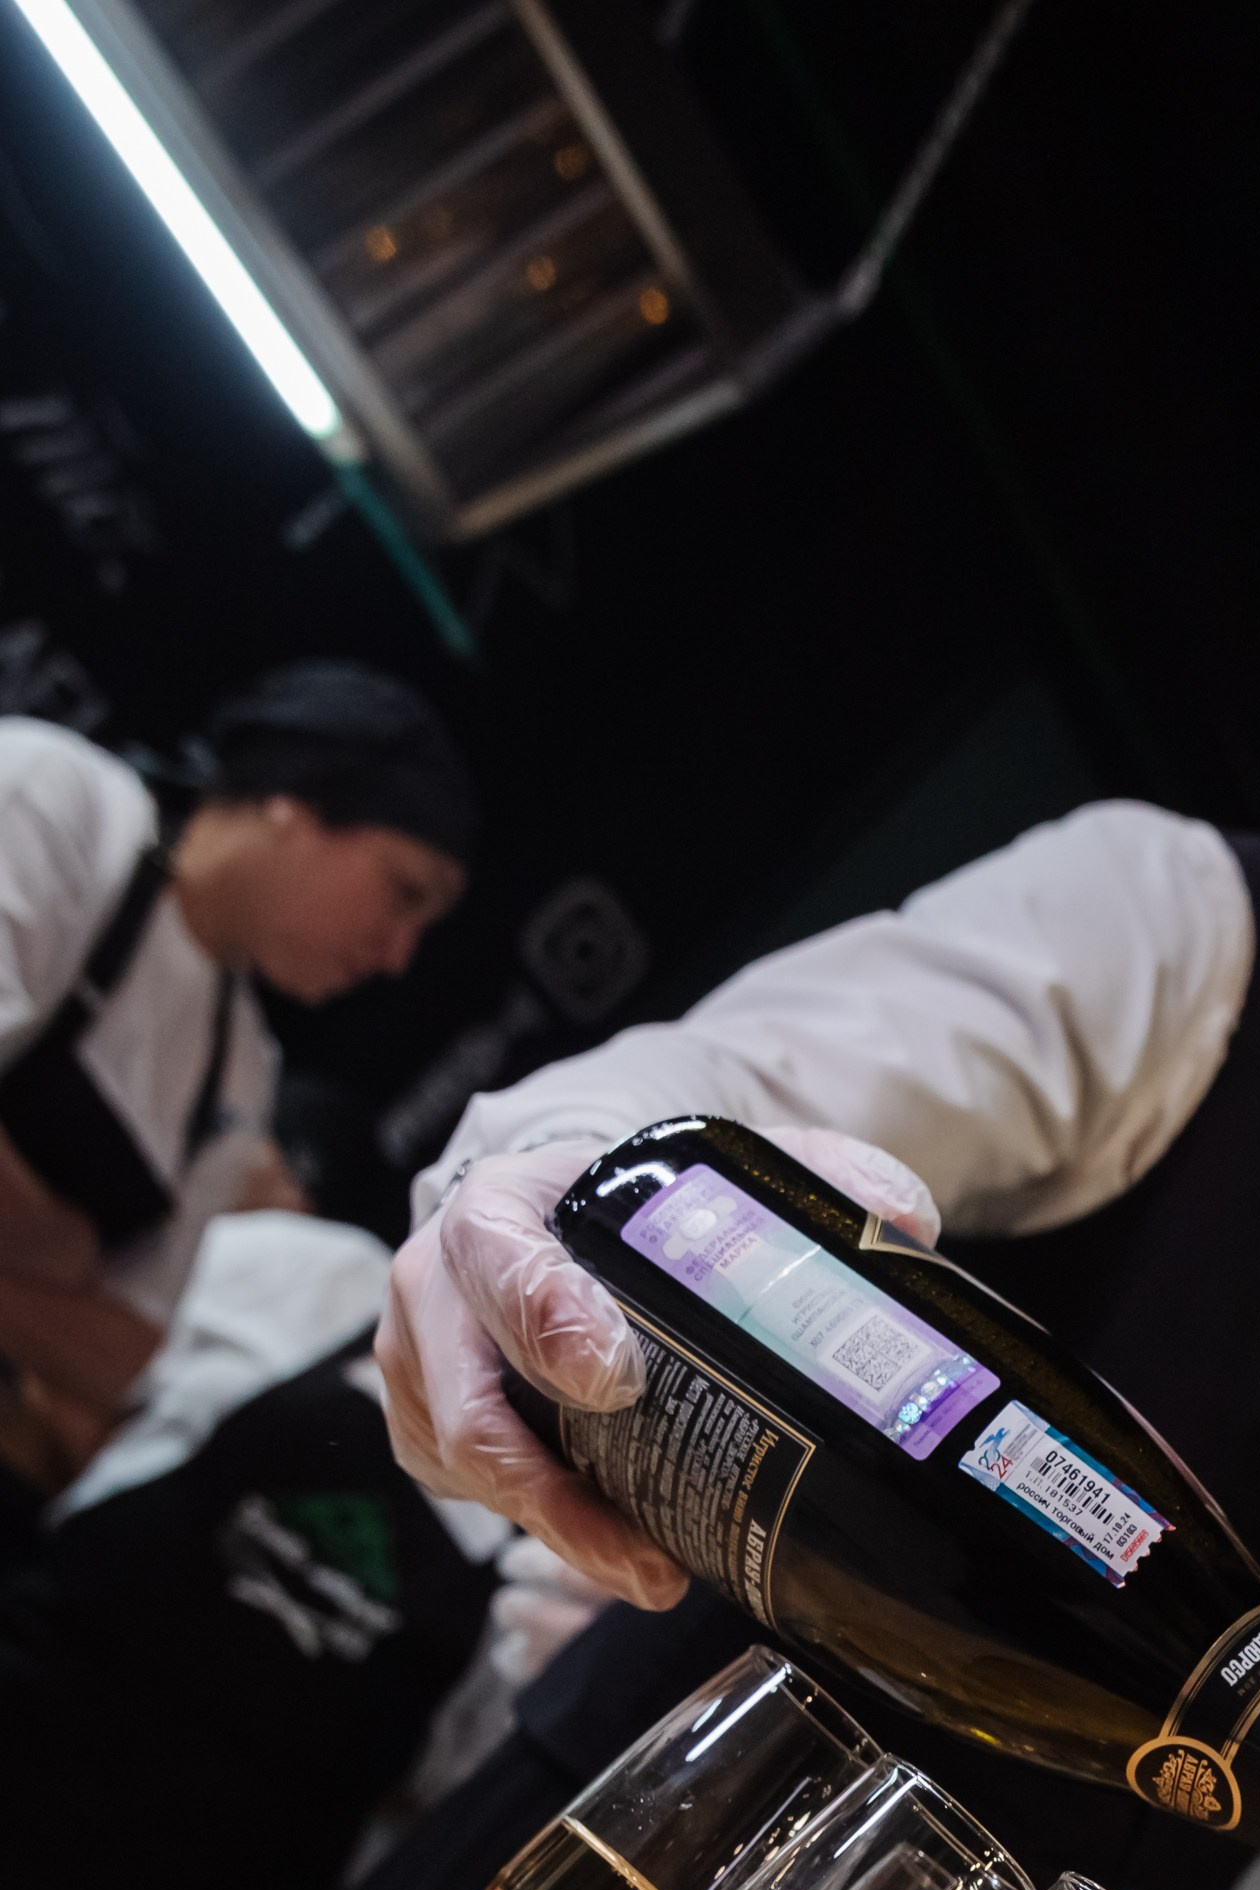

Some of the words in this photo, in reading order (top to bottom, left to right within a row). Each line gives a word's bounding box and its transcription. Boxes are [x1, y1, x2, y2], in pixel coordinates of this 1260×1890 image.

[719, 1236, 758, 1270] МАРКА
[1045, 1450, 1111, 1505] 07461941
[1044, 1484, 1083, 1517] 181537
[1052, 1505, 1095, 1543] торговый
[1093, 1539, 1115, 1561] дом
[1103, 1512, 1131, 1545] 17.10.24
